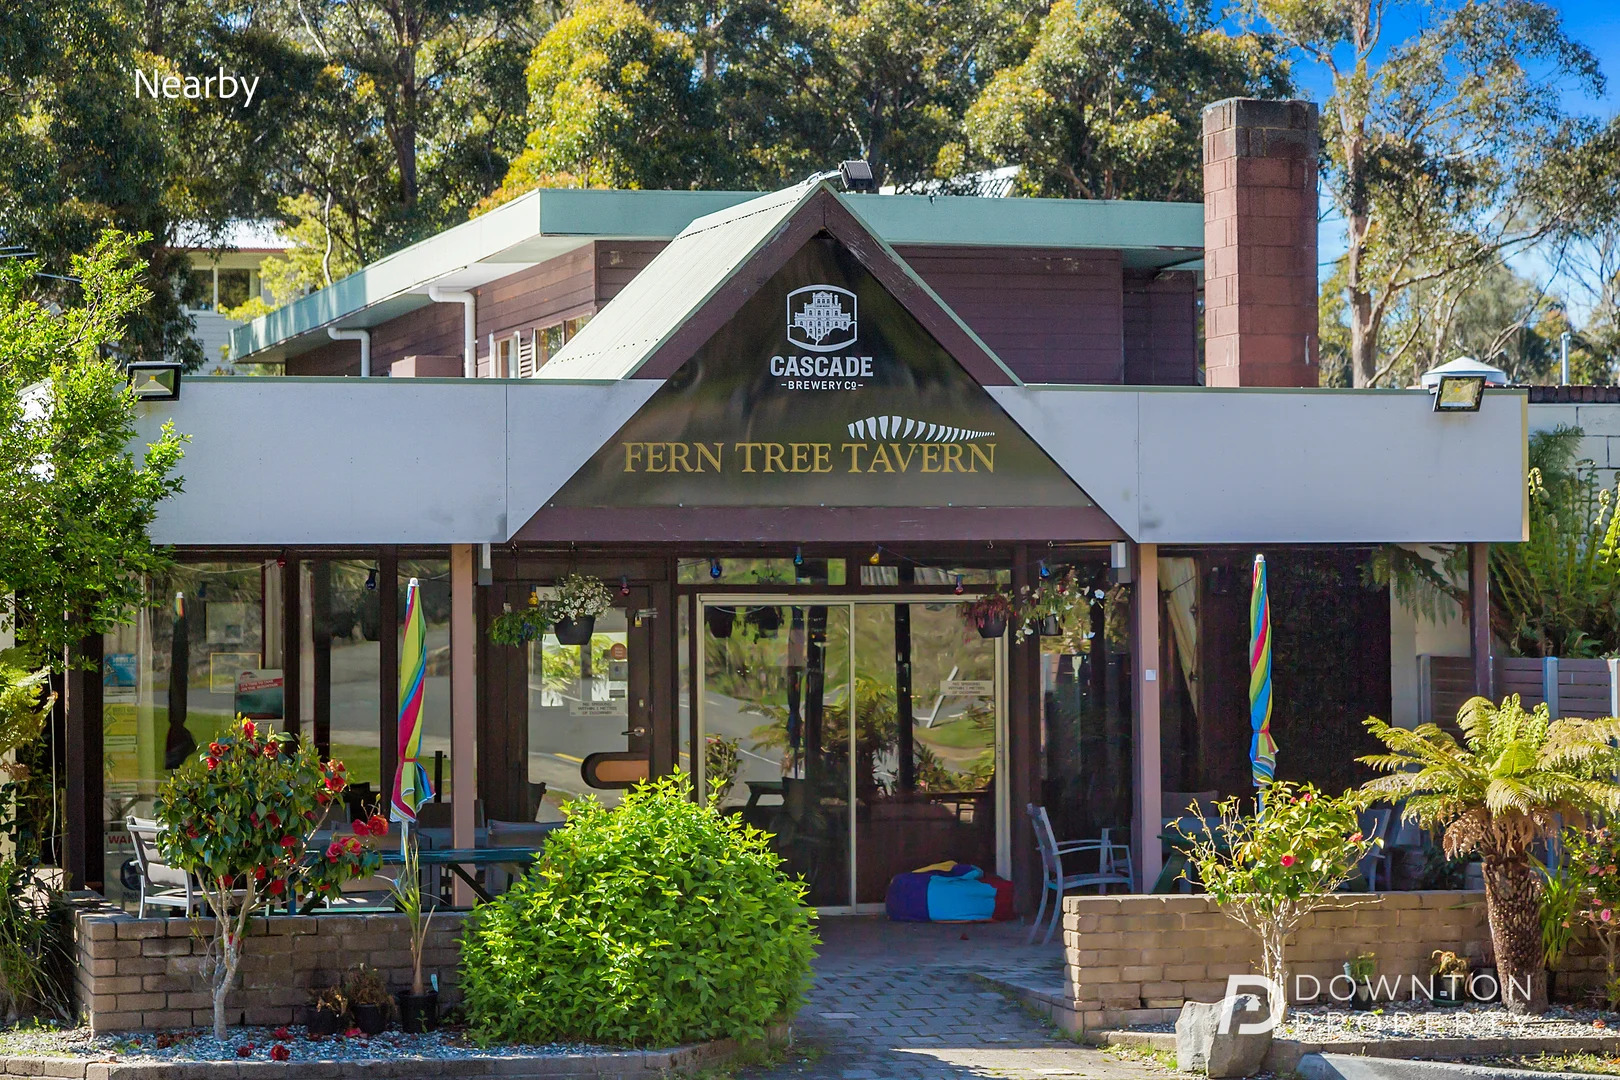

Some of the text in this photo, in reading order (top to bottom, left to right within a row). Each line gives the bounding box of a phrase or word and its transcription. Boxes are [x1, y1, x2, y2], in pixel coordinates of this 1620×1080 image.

[770, 356, 873, 378] CASCADE
[787, 380, 842, 391] BREWERY
[622, 442, 996, 474] FERN TREE TAVERN
